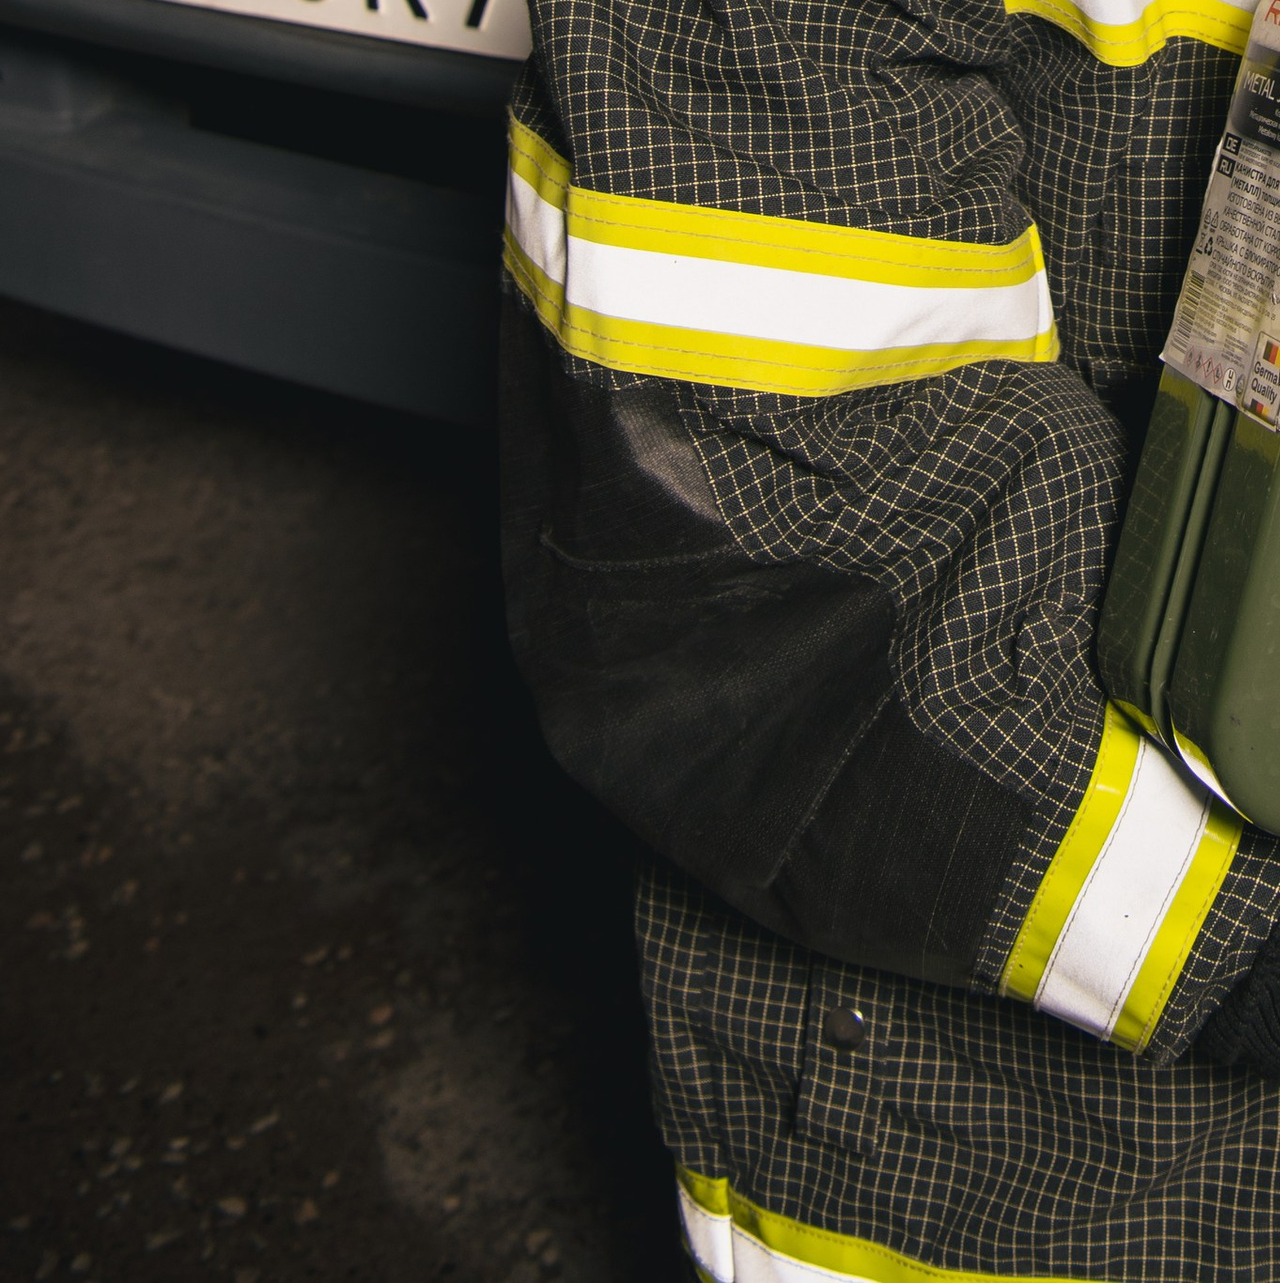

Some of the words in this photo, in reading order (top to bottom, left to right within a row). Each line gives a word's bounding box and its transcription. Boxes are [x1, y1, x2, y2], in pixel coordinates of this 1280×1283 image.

[1243, 71, 1275, 101] METAL
[1224, 137, 1239, 152] DE
[1219, 158, 1232, 175] RU
[1235, 162, 1266, 184] КАНИСТРА
[1265, 176, 1280, 190] ДЛЯ
[1230, 176, 1261, 200] (МЕТАЛЛ)
[1264, 208, 1274, 221] ИЗ
[1253, 236, 1263, 249] ОТ
[1251, 378, 1278, 405] Quality
